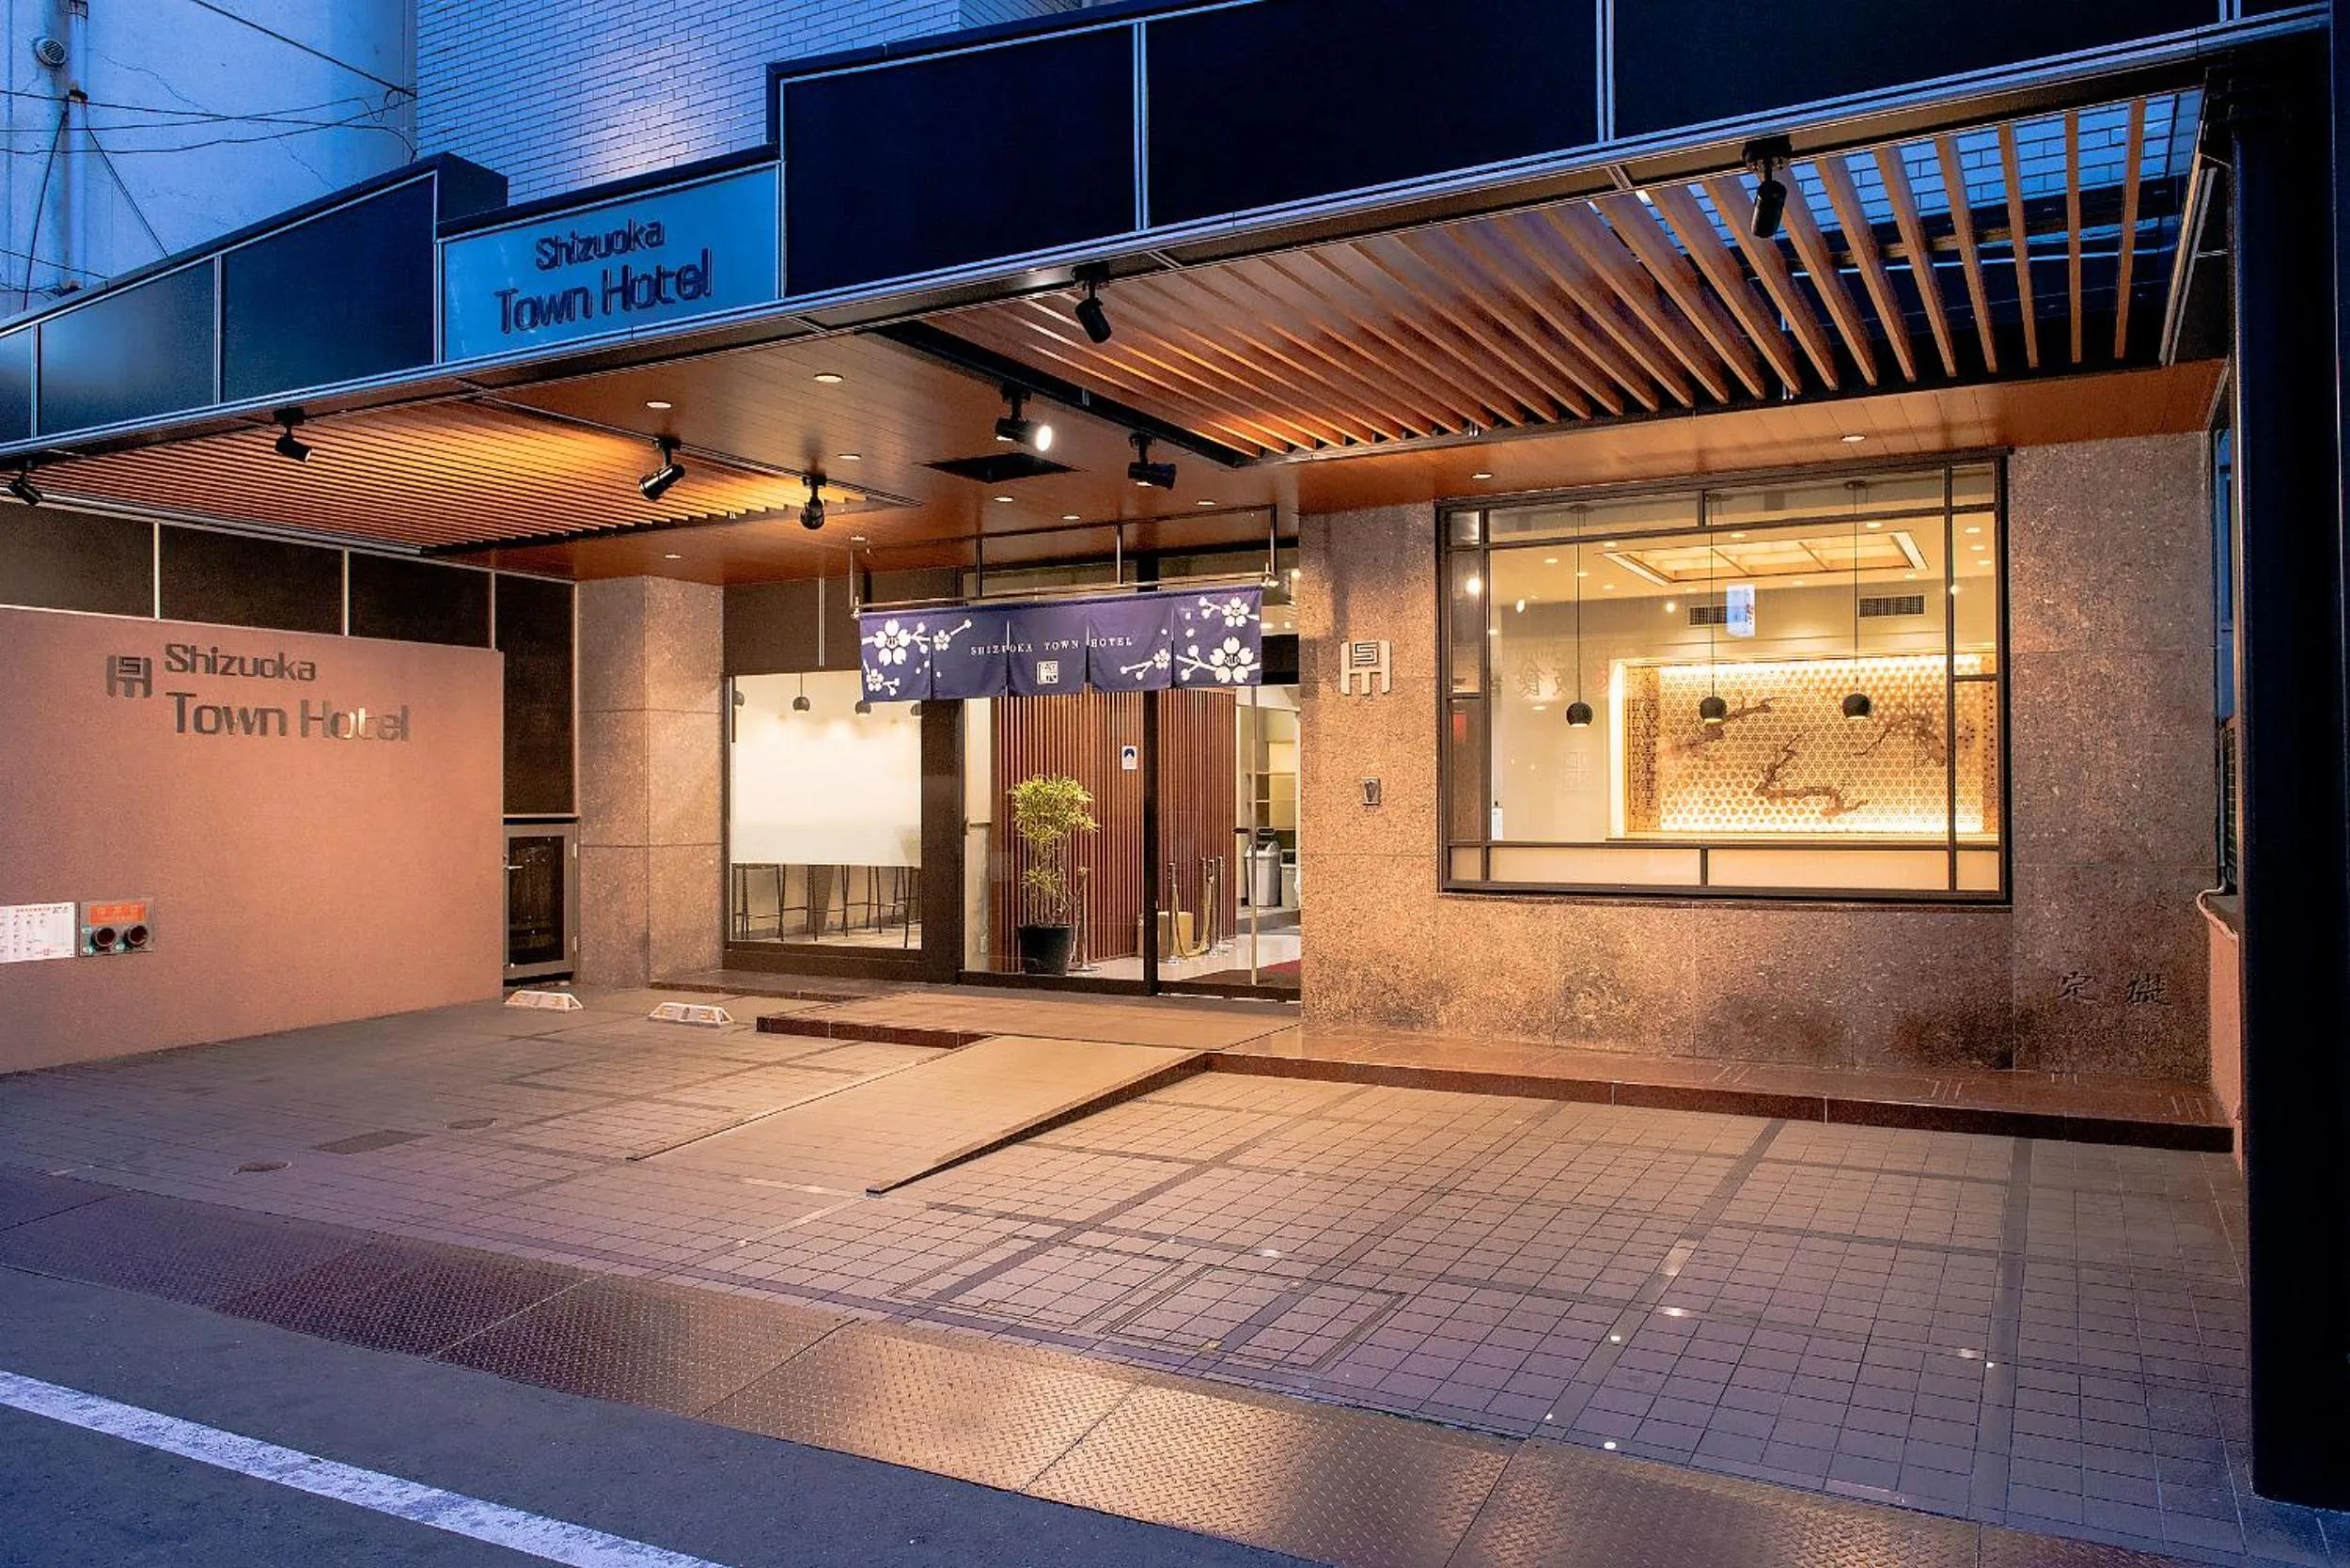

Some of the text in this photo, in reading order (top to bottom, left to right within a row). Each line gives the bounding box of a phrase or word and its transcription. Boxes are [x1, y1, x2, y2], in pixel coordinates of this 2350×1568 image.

[536, 218, 666, 271] Shizuoka
[494, 247, 713, 335] Town Hotel
[164, 643, 317, 682] Shizuoka
[1044, 640, 1079, 651] TOWN
[1090, 637, 1132, 648] HOTEL
[165, 691, 410, 742] Town Hotel
